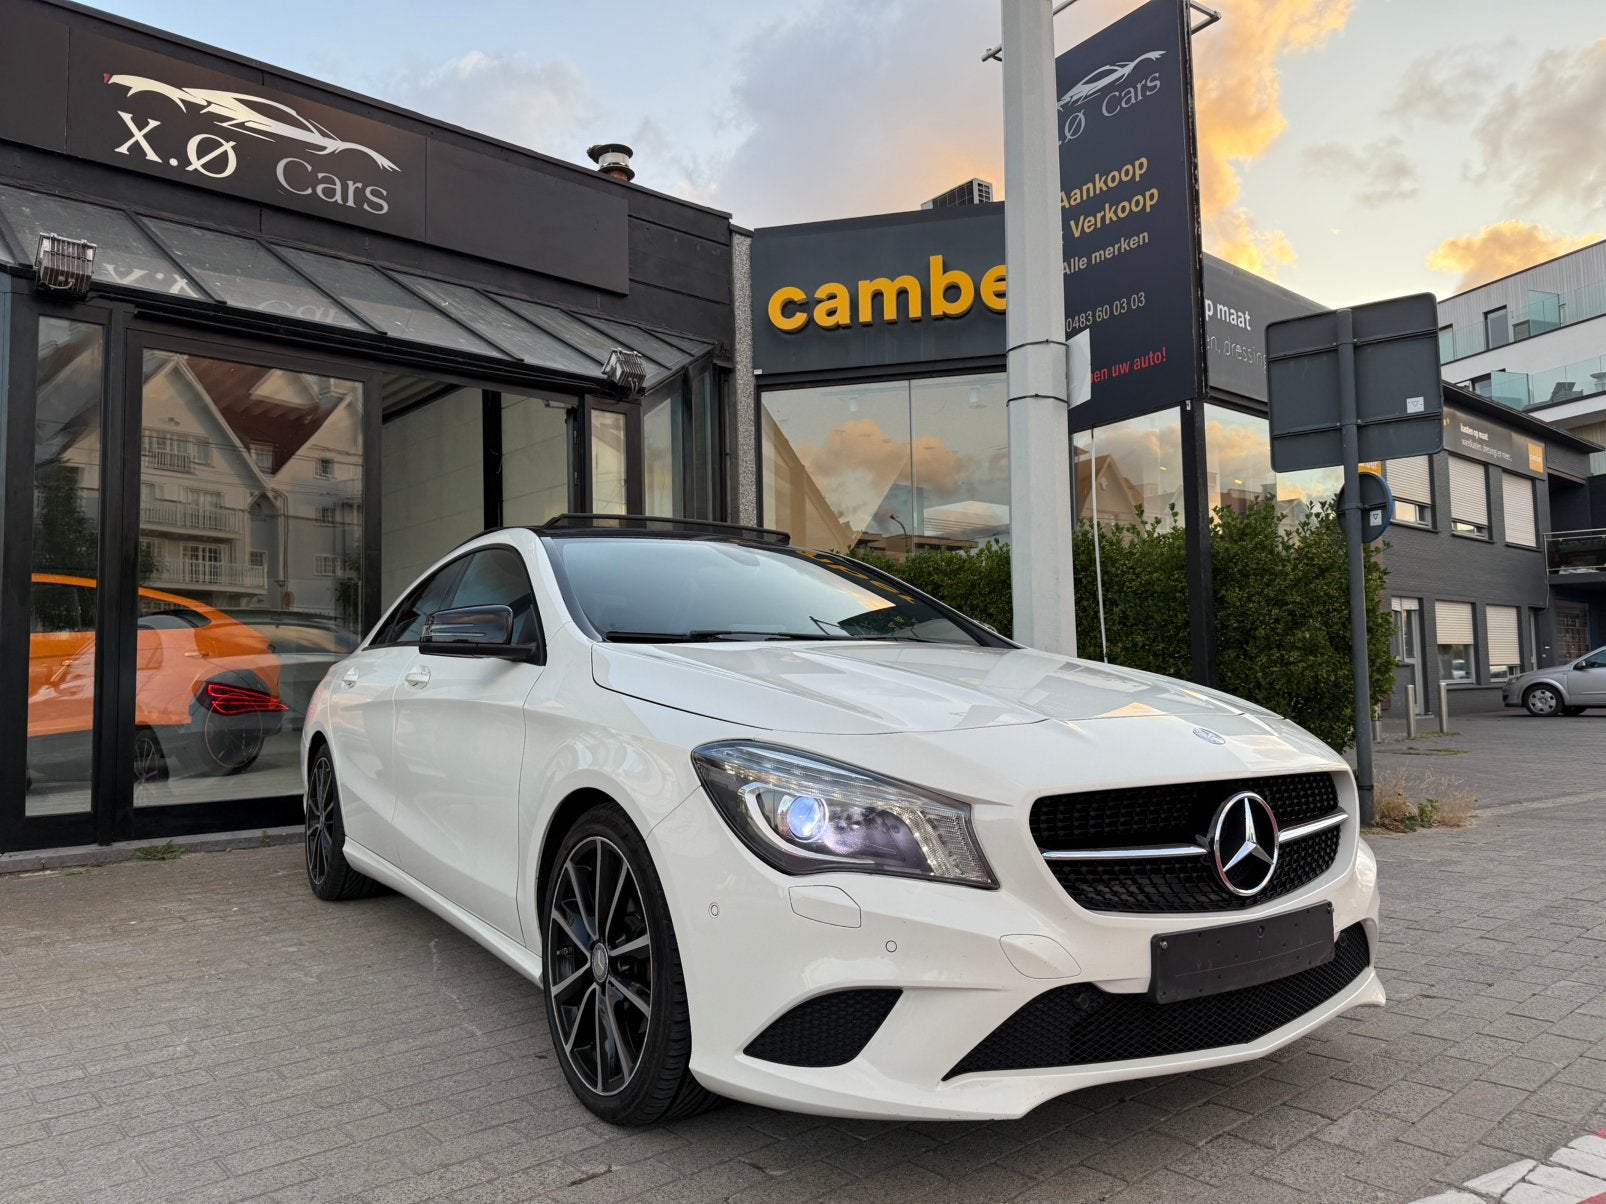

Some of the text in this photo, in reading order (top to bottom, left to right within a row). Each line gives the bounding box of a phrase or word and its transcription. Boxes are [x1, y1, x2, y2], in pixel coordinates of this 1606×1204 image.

[1101, 72, 1161, 117] Cars
[113, 110, 389, 215] X.Ø Cars
[1060, 157, 1148, 209] Aankoop
[1070, 188, 1159, 238] Verkoop
[1063, 231, 1149, 275] Alle merken
[768, 254, 1007, 333] cambe
[1066, 292, 1146, 332] 0483 60 03 03
[1205, 298, 1251, 331] p maat
[1112, 360, 1130, 377] uw
[1134, 346, 1167, 371] auto!
